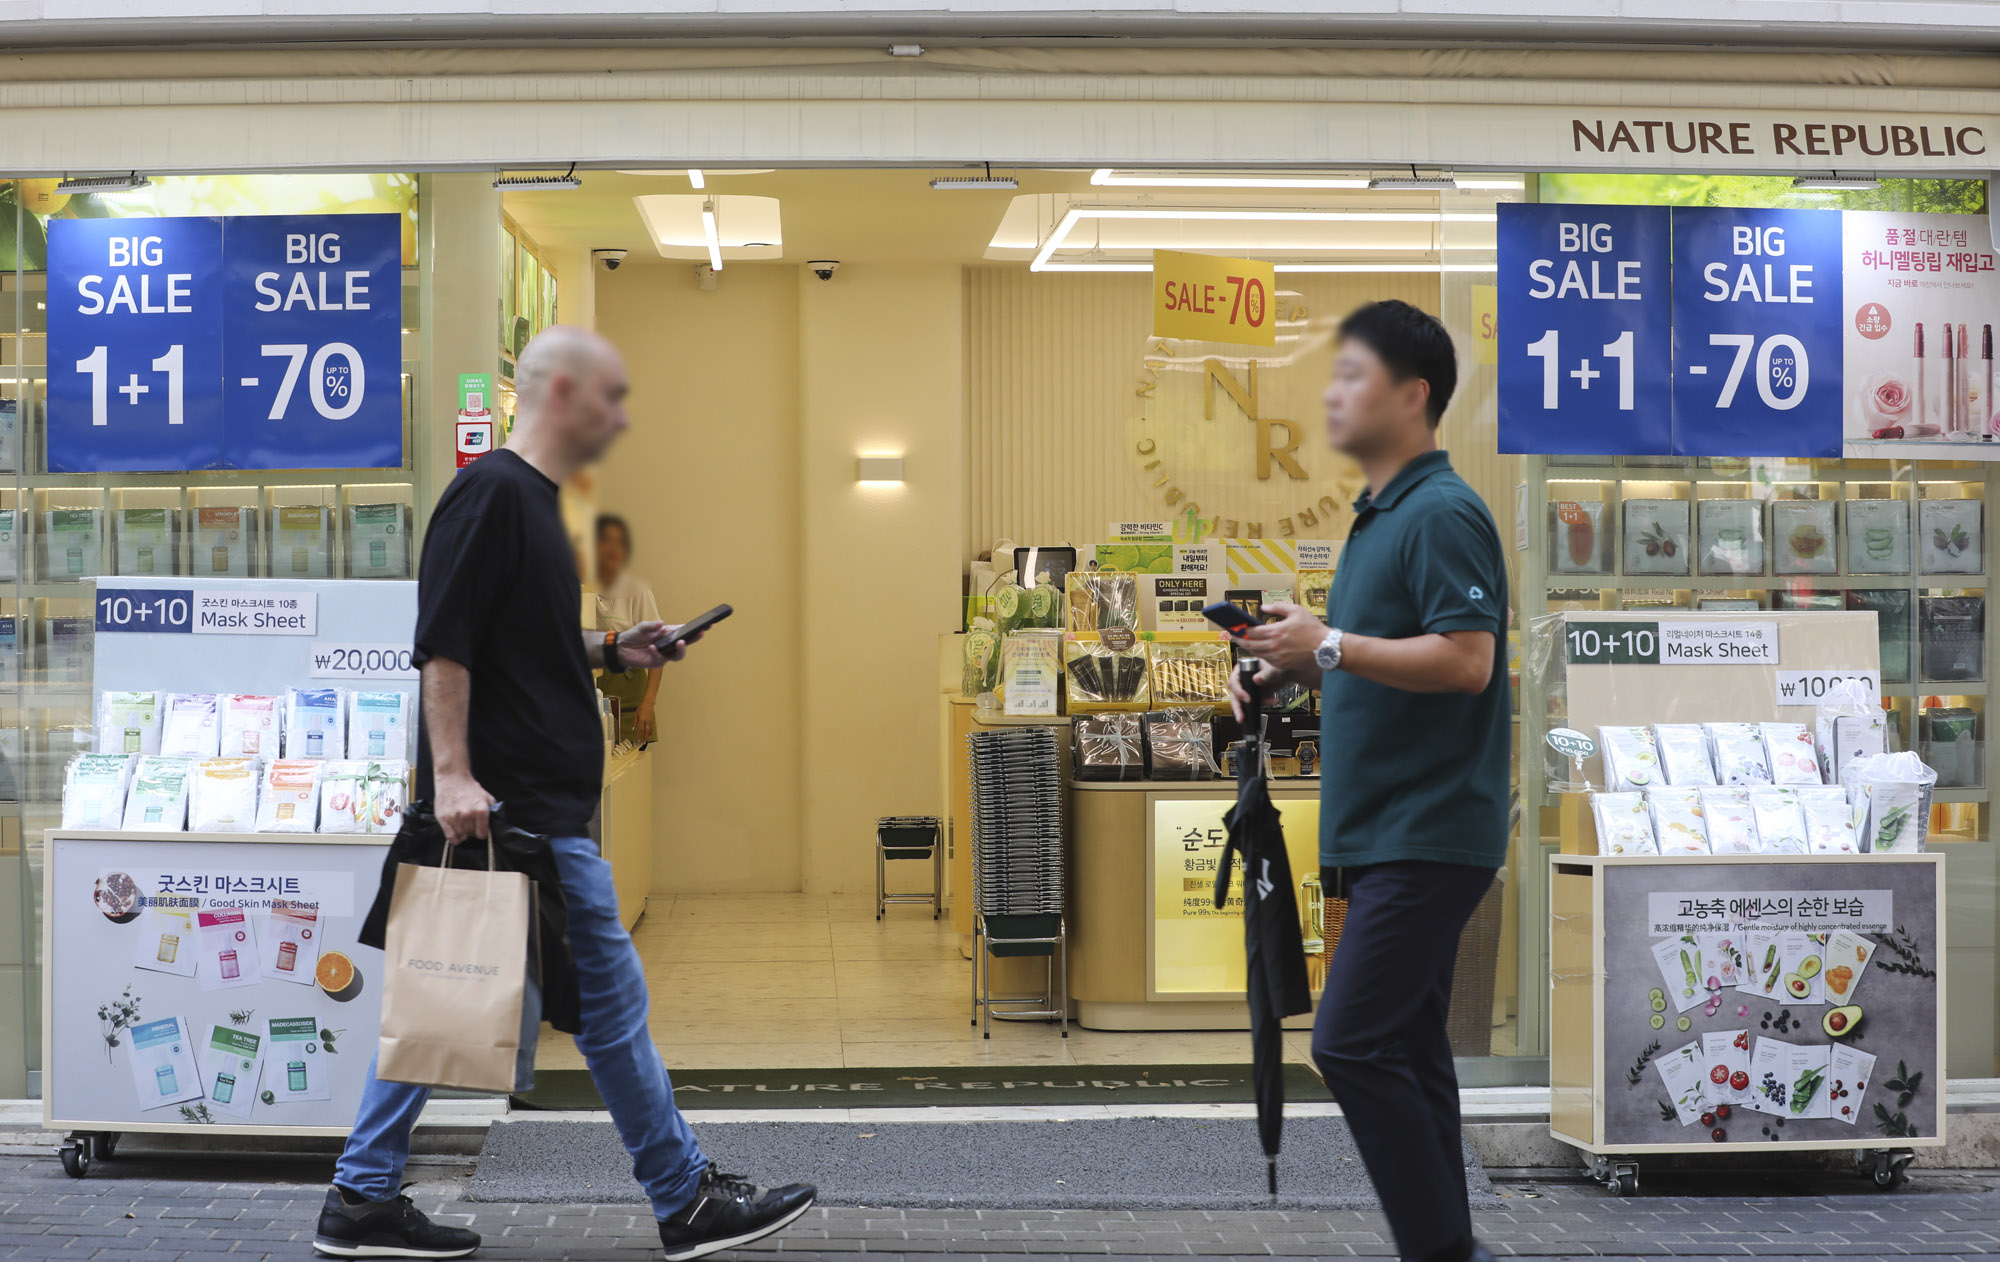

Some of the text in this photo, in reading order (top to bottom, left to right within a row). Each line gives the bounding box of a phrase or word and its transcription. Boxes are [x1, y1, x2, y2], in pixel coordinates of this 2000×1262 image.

[1573, 120, 1986, 156] NATURE REPUBLIC
[286, 233, 341, 264] BIG
[1559, 223, 1613, 253] BIG
[1733, 226, 1785, 256] BIG
[109, 236, 163, 267] BIG
[1862, 250, 1996, 273] 허니멜팅립 재입고
[254, 270, 370, 312] SALE
[1529, 259, 1642, 301] SALE
[1703, 263, 1814, 304] SALE
[1887, 279, 1902, 288] 지금
[1904, 279, 1918, 288] 바로
[78, 273, 193, 315] SALE
[1165, 281, 1215, 314] SALE
[241, 342, 366, 421] -70
[1527, 330, 1634, 411] 1+1
[1690, 334, 1809, 410] -70
[1772, 367, 1793, 388] %
[76, 344, 184, 426] 1+1
[326, 376, 348, 397] %
[1120, 523, 1163, 531] 강력한 비타민C
[1563, 512, 1578, 521] 1+1
[1159, 580, 1204, 588] ONLY HERE
[100, 597, 188, 625] 10+10
[201, 598, 298, 609] 굿스킨 마스크시트 10종
[201, 611, 306, 628] Mask Sheet
[1568, 629, 1655, 657] 10+10
[1666, 629, 1763, 639] 리얼네이처 마스크시트 14종
[1667, 642, 1769, 658] Mask Sheet
[1551, 735, 1594, 751] 10+10
[1184, 858, 1217, 871] 황금빛
[158, 874, 301, 895] 굿스킨 마스크시트
[137, 896, 200, 909] 美丽肌肤面膜
[210, 898, 235, 908] Good
[239, 898, 260, 908] Skin
[262, 899, 288, 909] Mask
[291, 900, 320, 910] Sheet
[1677, 896, 1865, 919] 고농축 에센스의 순한 보습
[1738, 923, 1760, 931] Gentle
[1761, 923, 1790, 931] moisture
[1790, 922, 1798, 930] of
[1798, 922, 1817, 932] highly
[1818, 921, 1861, 930] concentrated
[408, 959, 500, 976] FOOD AVENUE
[232, 1034, 257, 1045] TEA TREE
[672, 1078, 1230, 1092] ATURE REPUBLIC
